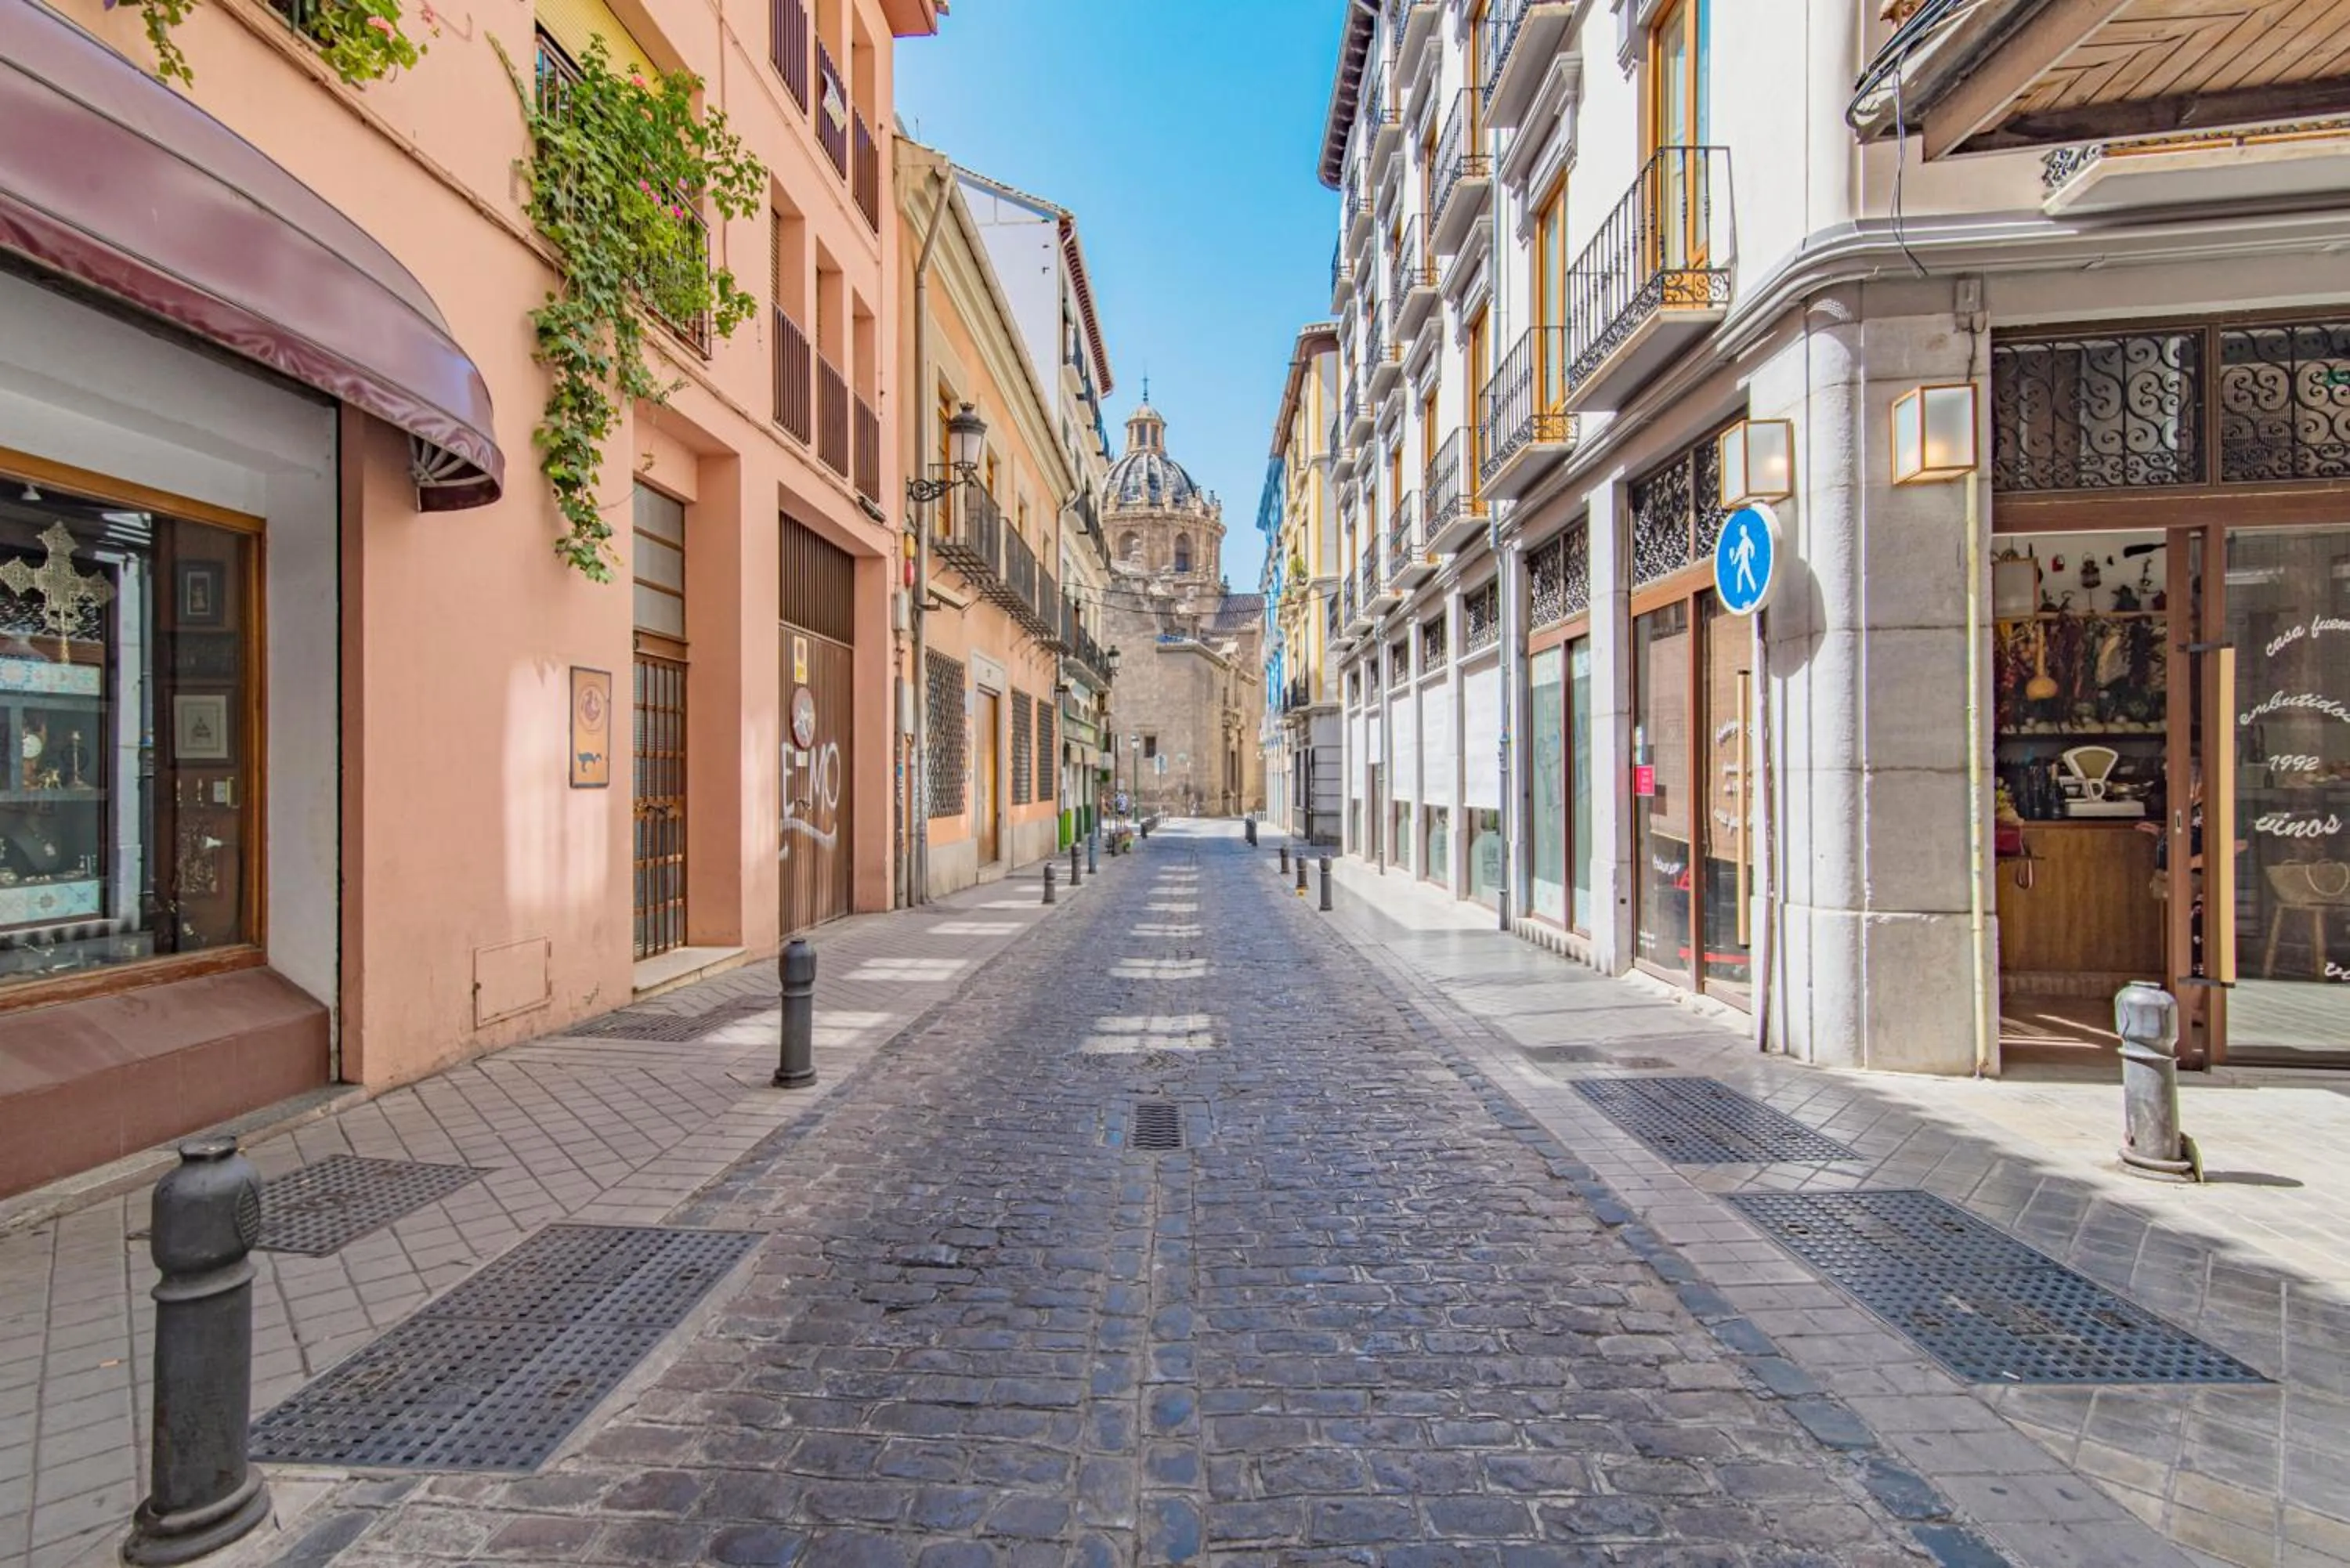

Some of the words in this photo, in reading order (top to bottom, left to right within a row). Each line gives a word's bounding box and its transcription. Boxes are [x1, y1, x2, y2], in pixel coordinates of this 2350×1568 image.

[2266, 625, 2305, 656] casa
[2269, 754, 2319, 771] 1992
[2254, 812, 2342, 837] vinos
